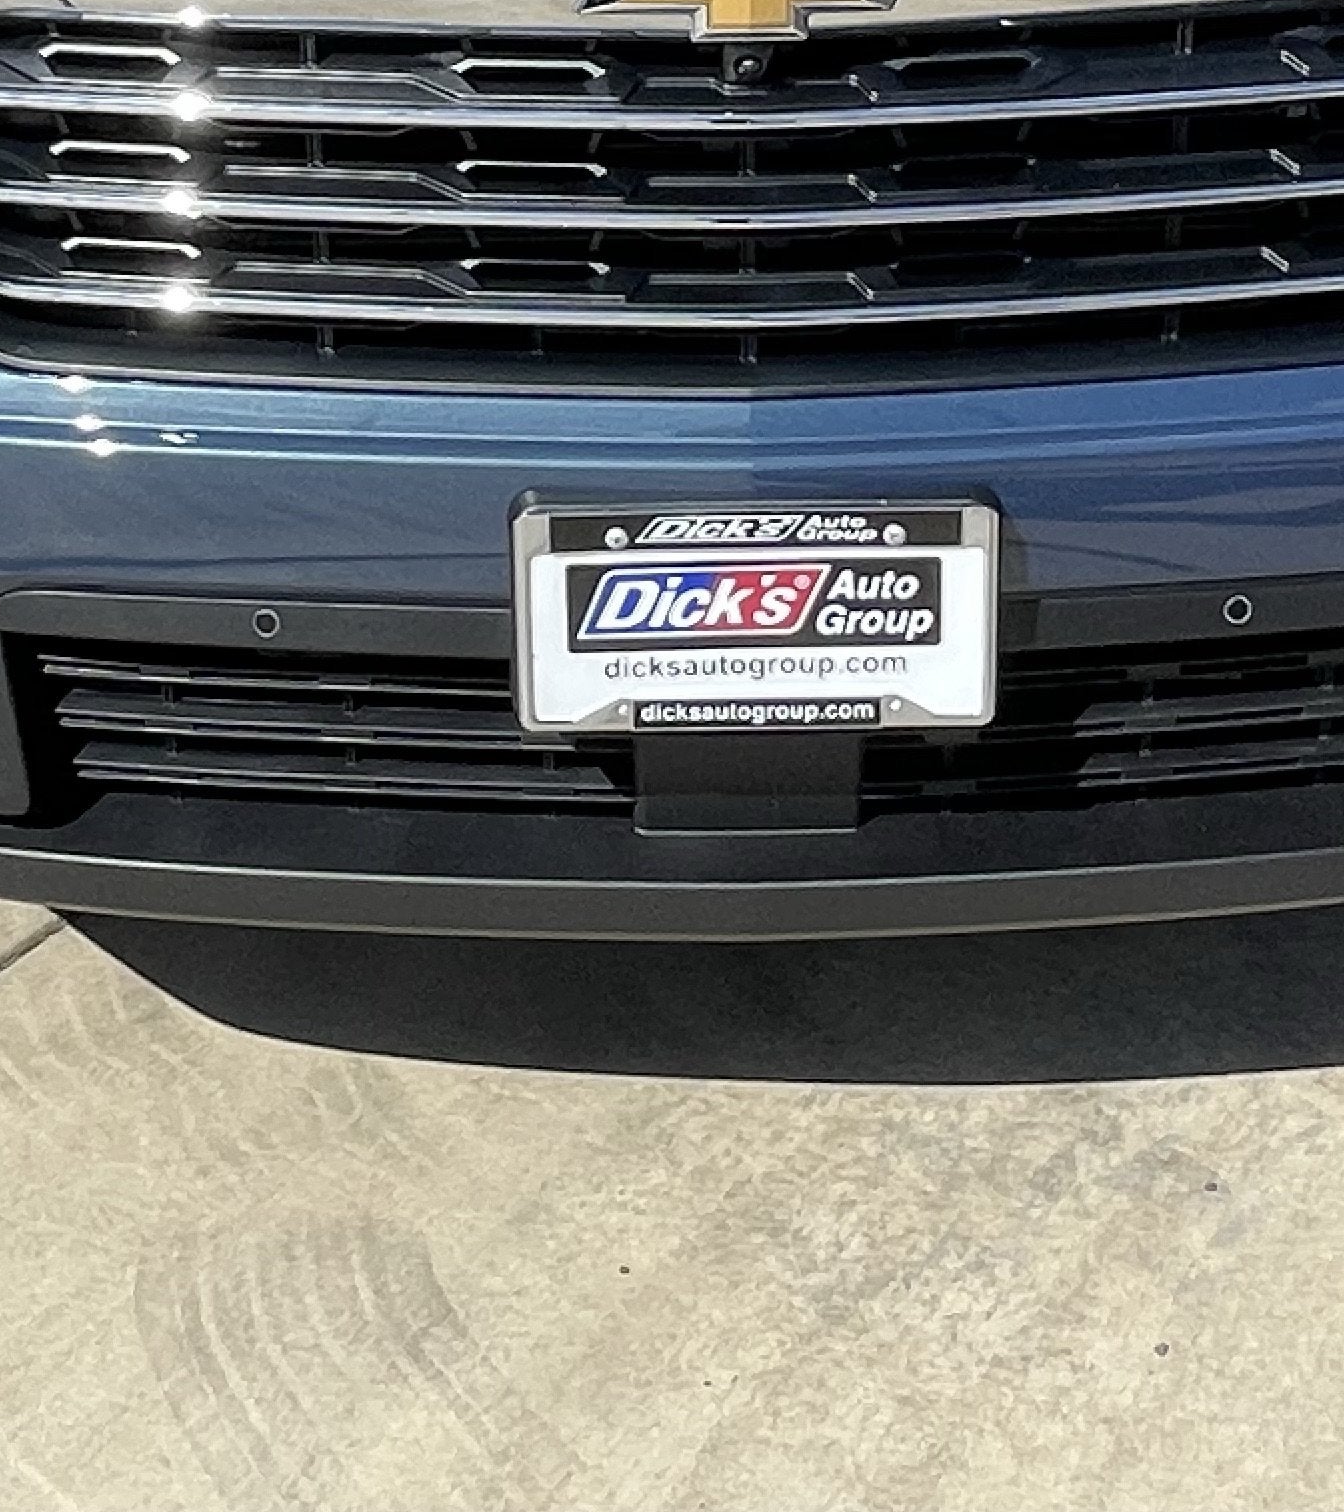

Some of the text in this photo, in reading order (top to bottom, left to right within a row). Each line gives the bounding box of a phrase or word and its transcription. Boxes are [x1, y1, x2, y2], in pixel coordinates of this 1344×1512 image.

[806, 514, 867, 528] Auto
[796, 527, 878, 543] Group
[827, 568, 921, 600] Auto
[595, 573, 798, 630] Dick's
[815, 604, 935, 642] Group
[604, 654, 910, 679] dicksautogroup.com
[639, 702, 876, 725] dicksautogroup.com
